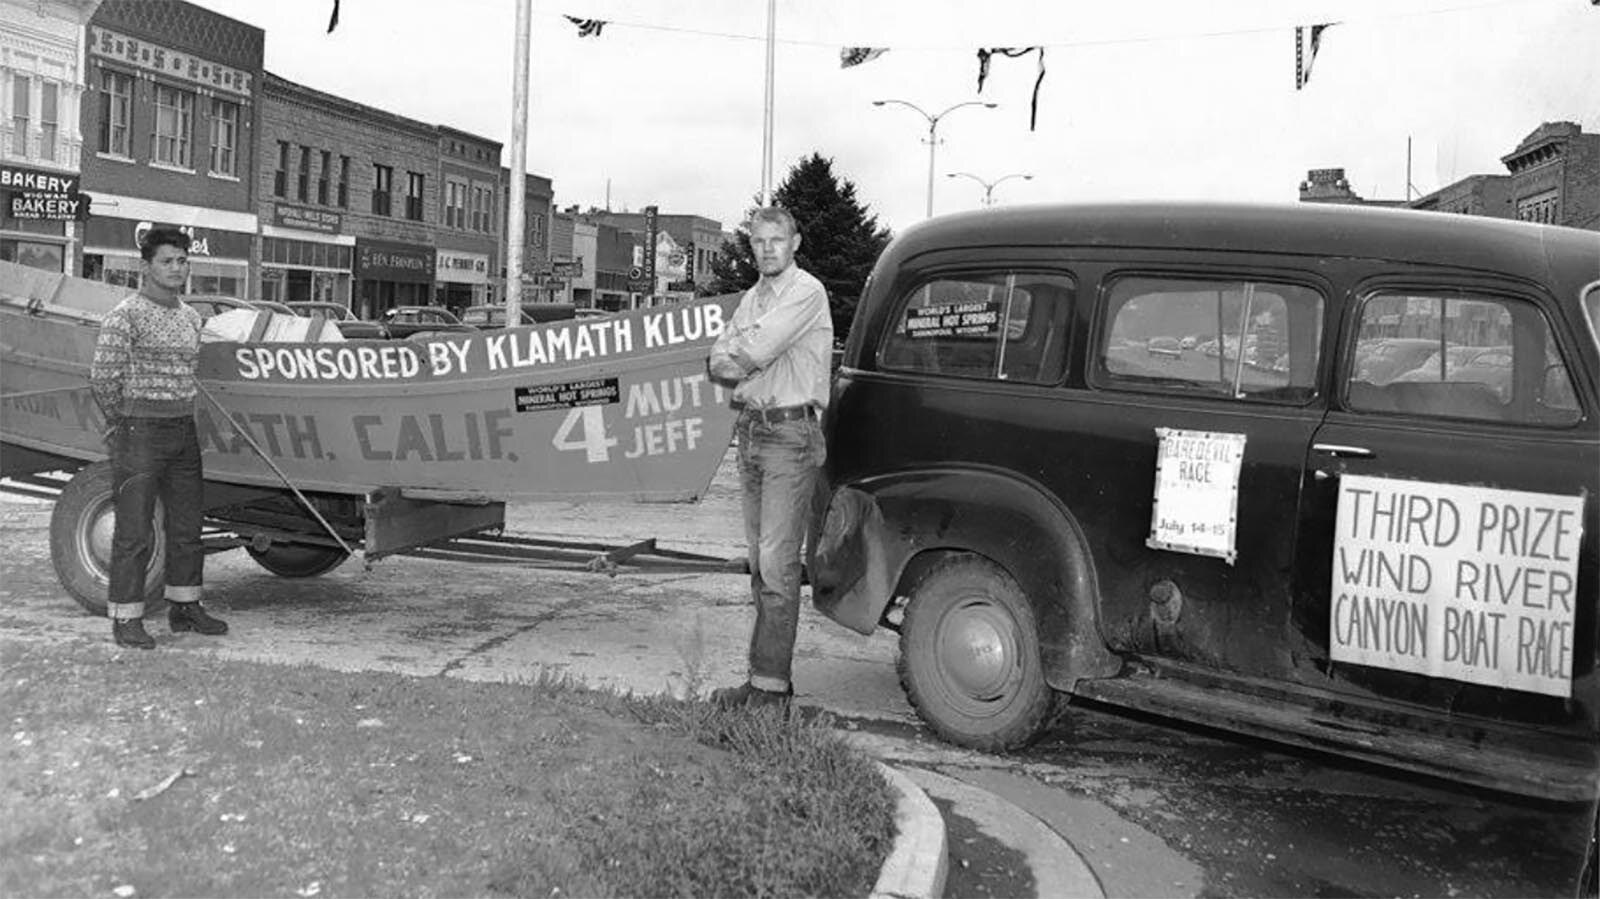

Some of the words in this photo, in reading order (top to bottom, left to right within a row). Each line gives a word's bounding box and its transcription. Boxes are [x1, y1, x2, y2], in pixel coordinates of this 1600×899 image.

[1, 170, 72, 193] BAKERY
[12, 198, 79, 214] BAKERY
[907, 316, 940, 329] MINERAL
[943, 314, 960, 327] HOT
[961, 311, 997, 326] SPRINGS
[235, 347, 420, 380] SPONSORED
[428, 339, 471, 376] BY
[486, 319, 632, 371] KLAMATH
[643, 303, 723, 349] KLUB
[559, 391, 578, 402] HOT
[580, 386, 618, 400] SPRINGS
[352, 409, 519, 461] CALIF.
[551, 404, 618, 463] 4
[625, 418, 702, 459] JEFF
[1164, 438, 1231, 463] DAREDEVIL
[1179, 461, 1212, 483] RACE
[1158, 518, 1185, 535] July
[1345, 488, 1460, 548] THIRD
[1478, 502, 1574, 561] PRIZE
[1340, 546, 1432, 595] WIND
[1456, 560, 1573, 613] RIVER
[1335, 593, 1428, 659] CANYON
[1443, 606, 1507, 670] BOAT
[1517, 616, 1572, 680] RACE
